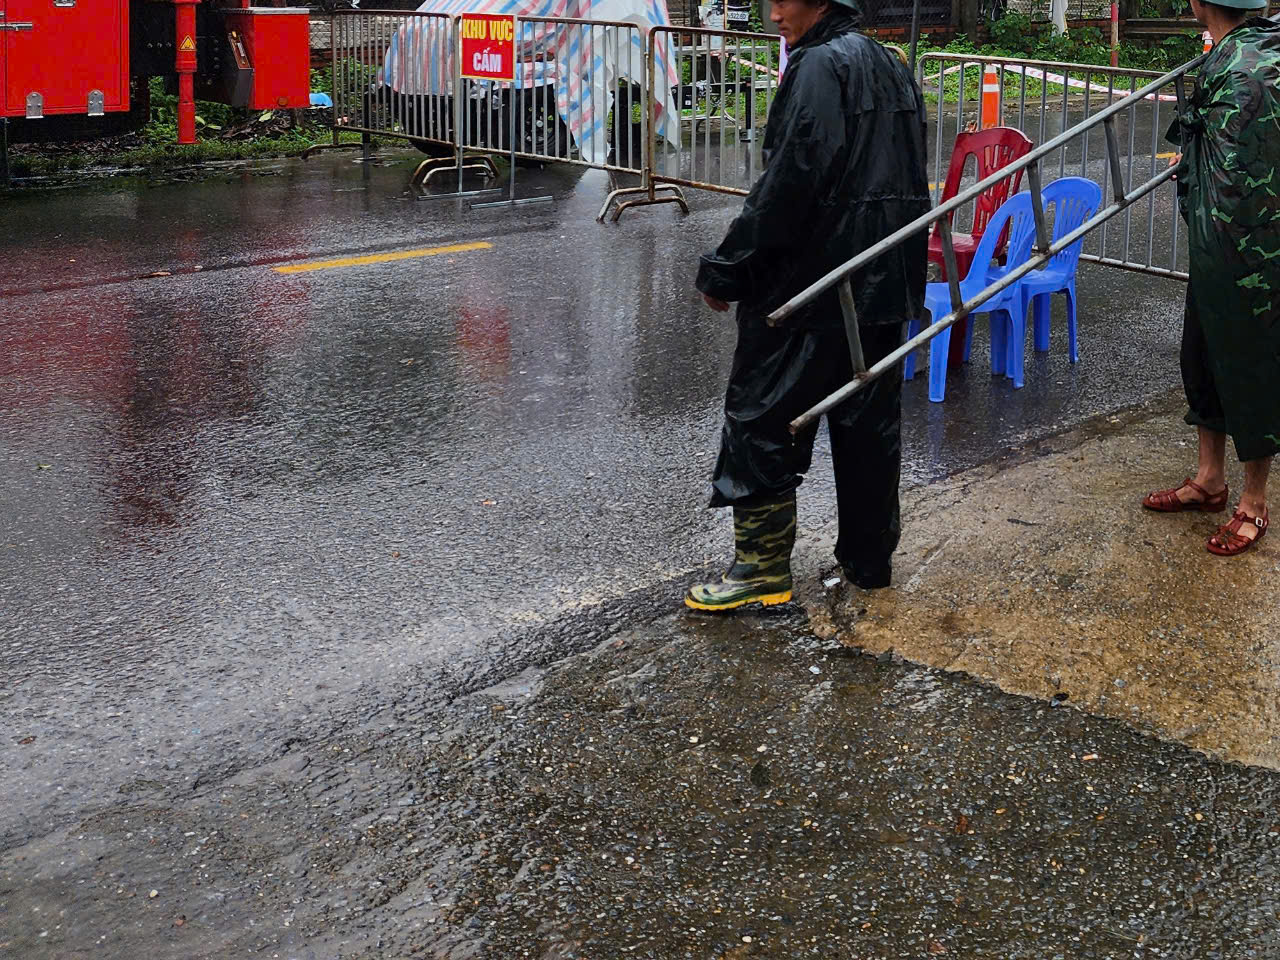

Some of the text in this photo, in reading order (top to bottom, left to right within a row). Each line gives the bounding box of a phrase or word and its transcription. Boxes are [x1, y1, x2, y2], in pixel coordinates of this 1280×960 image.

[462, 19, 513, 46] KHU VỰC
[473, 46, 502, 73] CẤM
